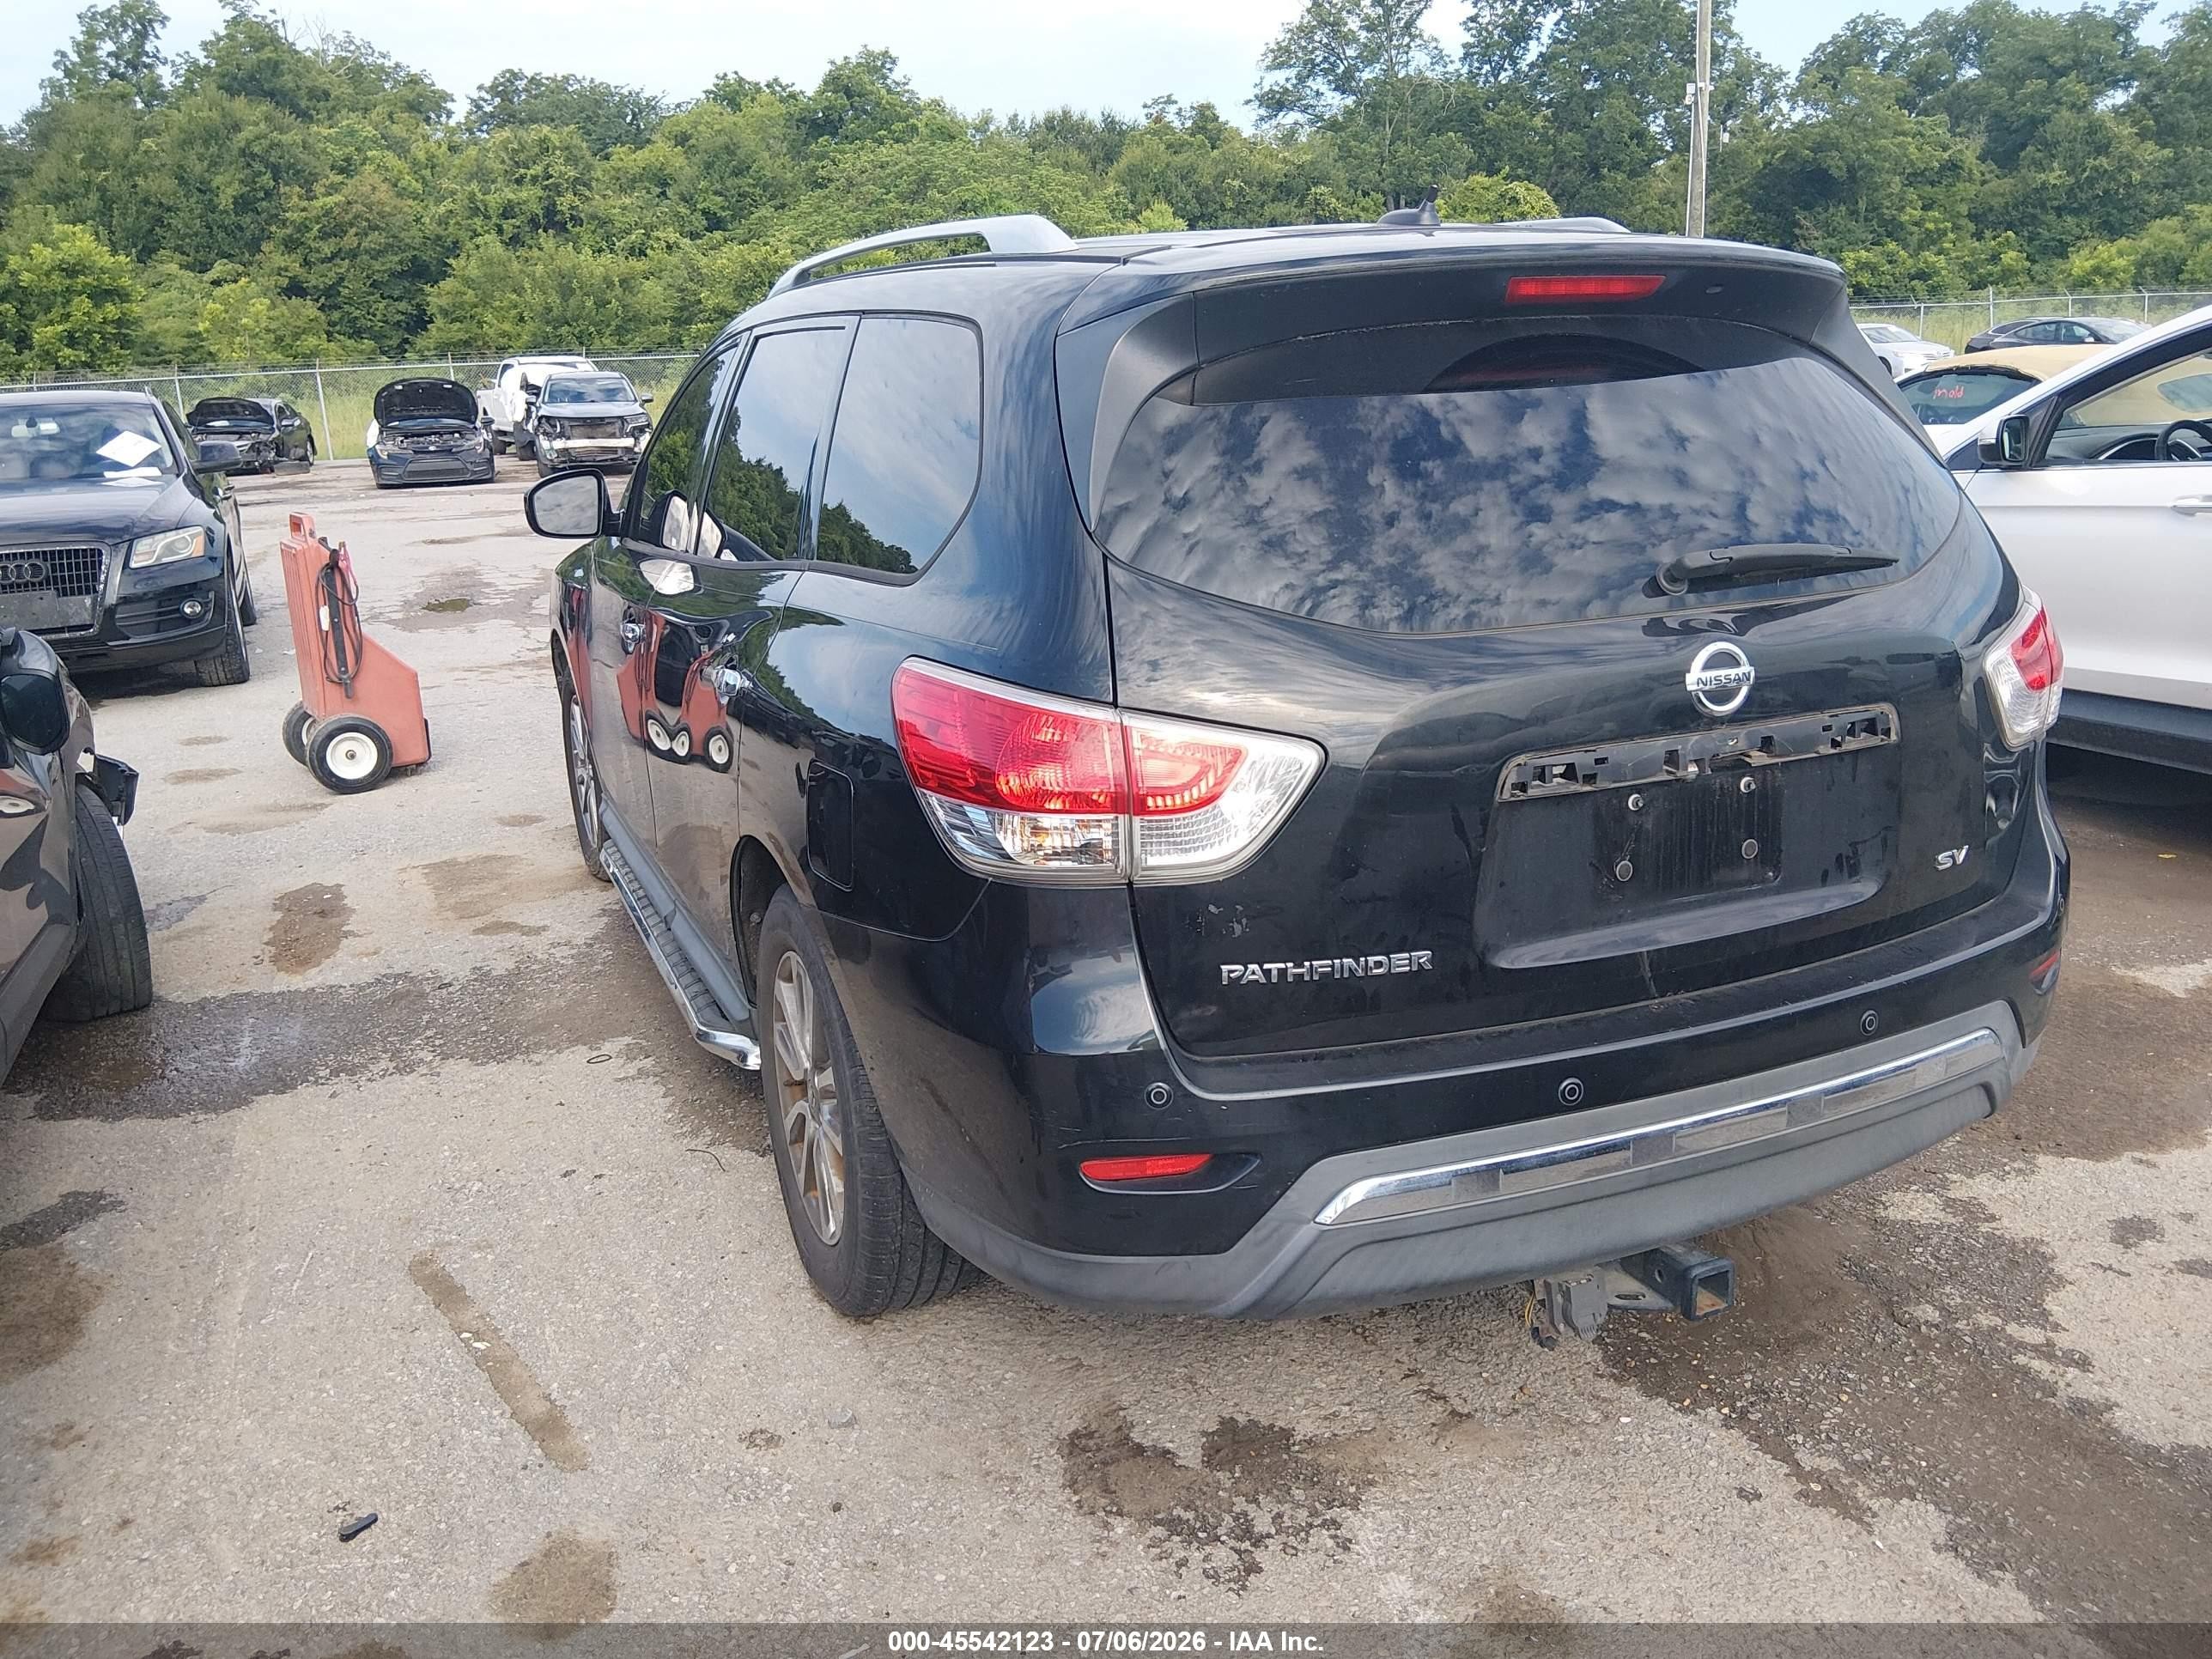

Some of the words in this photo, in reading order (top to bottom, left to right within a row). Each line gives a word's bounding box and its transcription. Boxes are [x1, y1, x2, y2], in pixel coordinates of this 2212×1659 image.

[1696, 672, 1751, 688] NISSAN
[1935, 845, 1969, 871] SV
[1219, 951, 1433, 985] PATHFINDER
